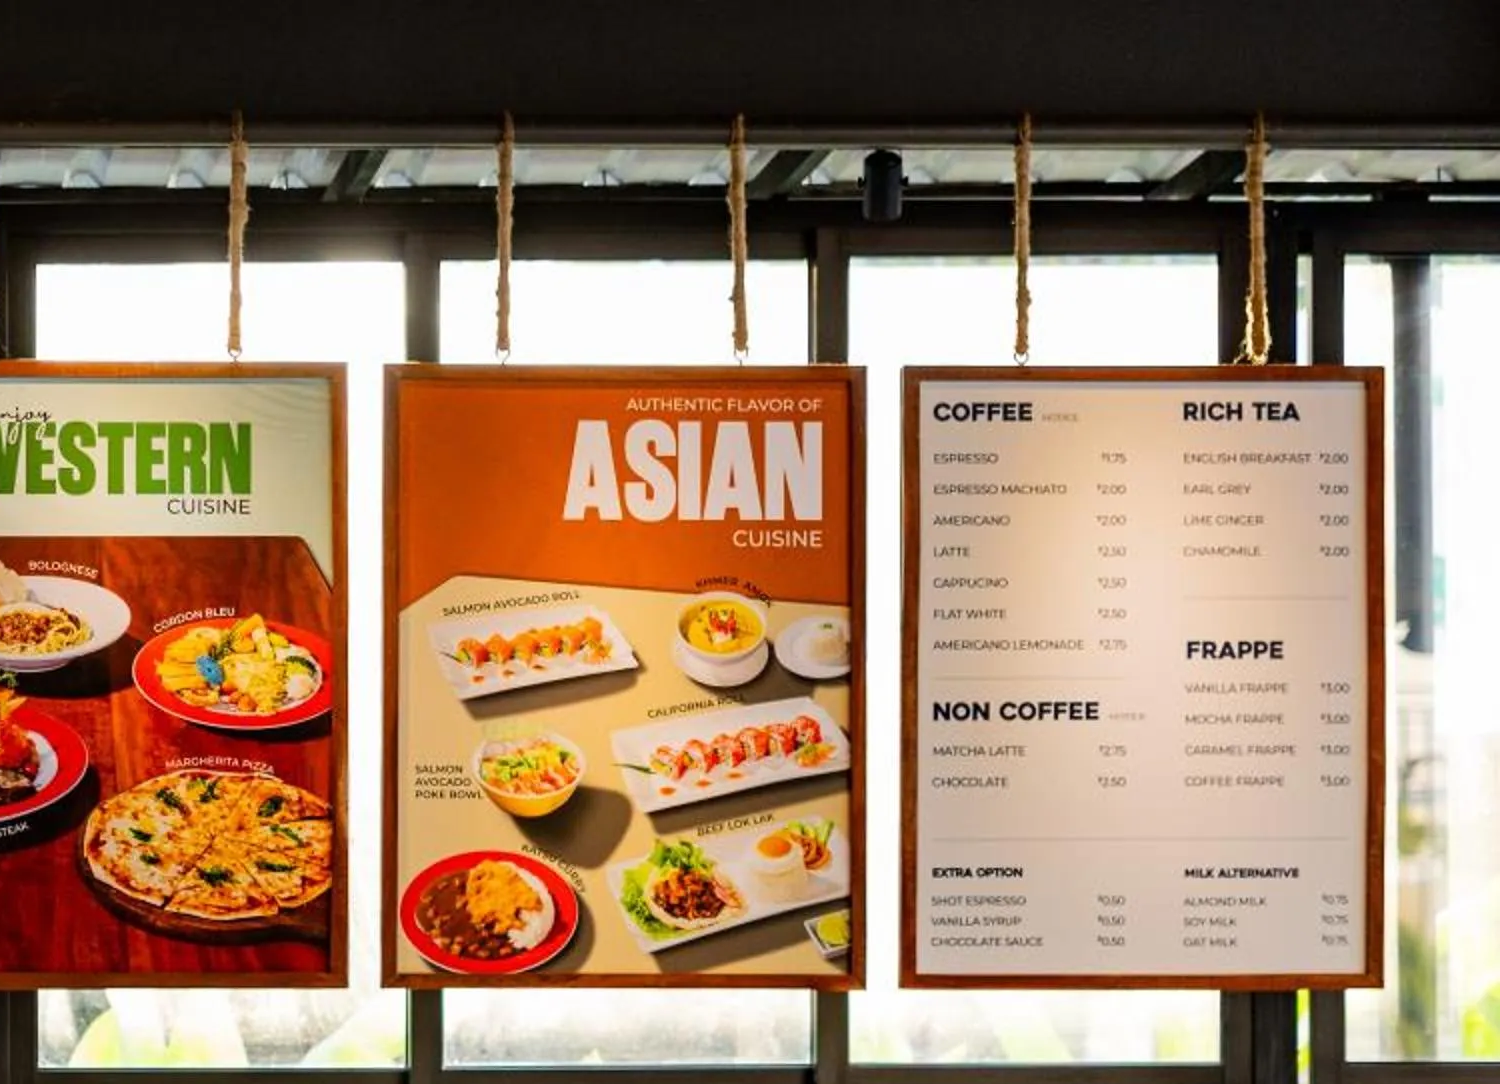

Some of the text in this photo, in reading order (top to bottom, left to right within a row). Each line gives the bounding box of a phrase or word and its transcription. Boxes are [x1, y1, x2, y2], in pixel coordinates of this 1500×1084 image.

[626, 397, 822, 412] AUTHENTIC FLAVOR OF
[933, 402, 1033, 422] COFFEE
[1183, 402, 1300, 421] RICH TEA
[933, 453, 998, 464] ESPRESSO
[1183, 453, 1237, 464] ENGLISH
[1240, 453, 1311, 464] BREAKFAST
[563, 419, 823, 522] ASIAN
[933, 484, 998, 495] ESPRESSO
[1001, 484, 1067, 495] MACHIATO
[1183, 484, 1215, 495] EARL
[1218, 484, 1251, 495] GREY
[167, 499, 251, 515] CUISINE
[933, 515, 1011, 526] AMERICANO
[1183, 515, 1213, 526] LIME
[1215, 515, 1264, 526] GINGER
[733, 529, 822, 548] CUISINE
[933, 546, 970, 557] LATTE
[1183, 546, 1261, 557] CHAMOMILE
[27, 560, 99, 579] BOLOGNESE
[933, 577, 1008, 588] CAPPUCINO
[443, 590, 580, 617] SALMON AVOCADO ROLL
[933, 608, 962, 620] FLAT
[966, 608, 1006, 620] WHITE
[153, 606, 236, 634] CORDON BLEU
[933, 639, 1011, 651] AMERICANO
[1013, 639, 1084, 651] LEMONADE
[1186, 641, 1284, 659] FRAPPE
[1184, 683, 1237, 694] VANILLA
[1239, 683, 1288, 694] FRAPPE
[647, 694, 745, 718] CALIFORNIA ROLL
[933, 702, 990, 721] NON
[999, 702, 1099, 721] COFFEE
[1184, 714, 1233, 725] MOCHA
[1236, 714, 1284, 725] FRAPPE
[932, 746, 986, 757] MATCHA
[989, 746, 1026, 757] LATTE
[1184, 745, 1243, 756] CARAMEL
[1247, 745, 1296, 756] FRAPPE
[165, 756, 275, 773] MARGHERITA PIZZA
[415, 765, 463, 775] SALMON
[415, 777, 472, 787] AVOCADO
[931, 777, 1008, 788] CHOCOLATE
[1184, 776, 1232, 787] COFFEE
[1236, 776, 1285, 787] FRAPPE
[415, 790, 484, 800] POKE BOWL
[726, 817, 753, 830] LOK
[754, 812, 775, 826] LAK
[555, 857, 585, 893] CURRY
[931, 867, 1023, 878] EXTRA OPTION
[1184, 868, 1300, 878] MILK ALTERNATIVE
[931, 896, 964, 906] SHOT
[965, 896, 1027, 906] ESPRESSO
[1183, 897, 1237, 907] ALMOND
[1239, 897, 1267, 907] MILK
[931, 916, 981, 927] VANILLA
[983, 916, 1022, 927] SYRUP
[1183, 917, 1207, 927] SOY
[1209, 917, 1237, 927] MILK
[931, 936, 1001, 947] CHOCOLATE
[1004, 936, 1043, 947] SAUCE
[1183, 937, 1207, 947] OAT
[1209, 937, 1237, 947] MILK
